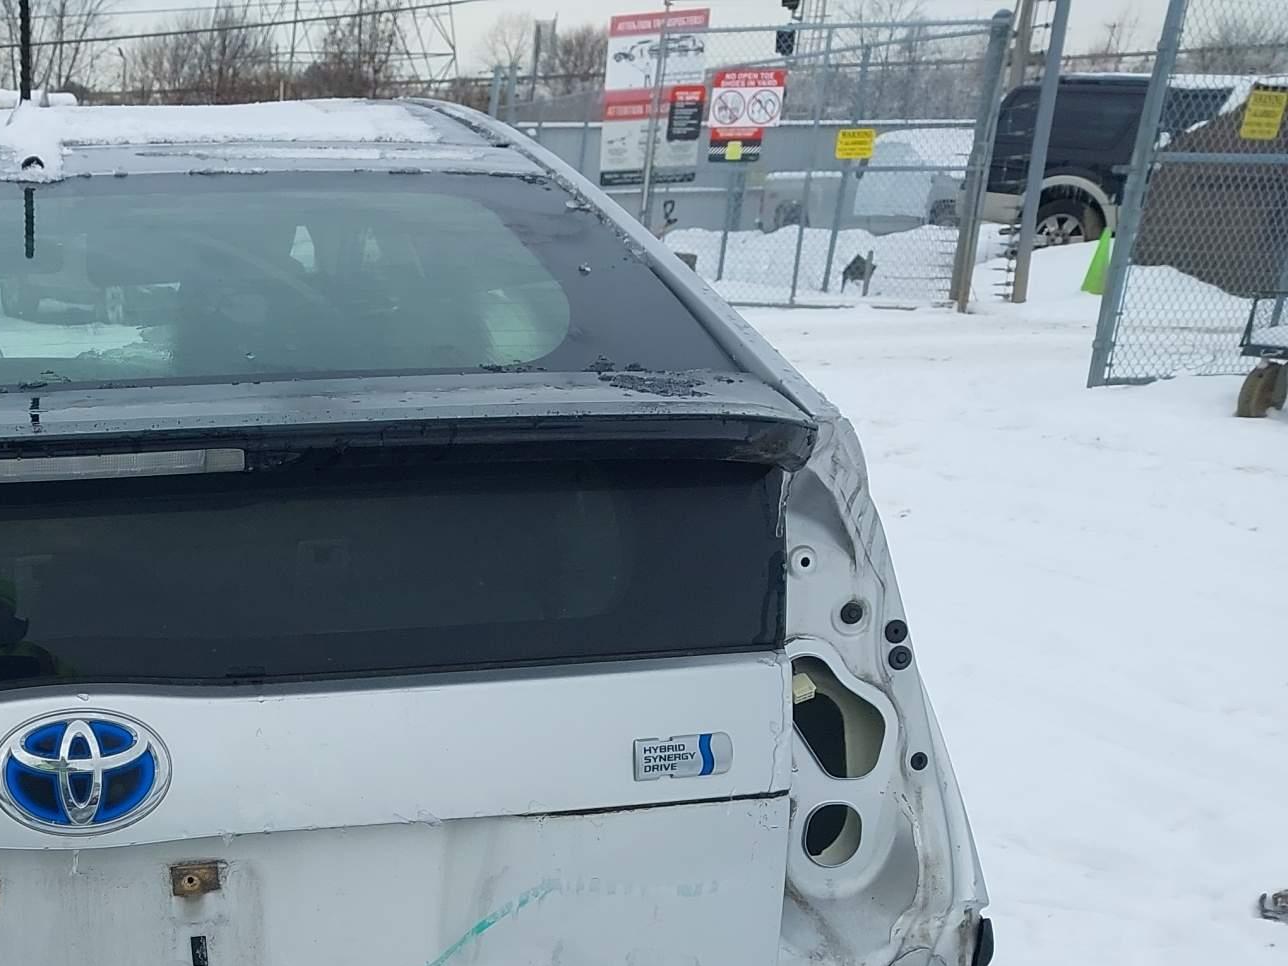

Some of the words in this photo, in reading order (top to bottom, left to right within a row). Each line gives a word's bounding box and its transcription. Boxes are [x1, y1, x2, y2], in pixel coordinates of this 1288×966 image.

[725, 72, 736, 80] NO
[643, 743, 686, 754] HYBRID
[643, 751, 697, 764] SYNERGY
[643, 762, 678, 773] DRIVE
